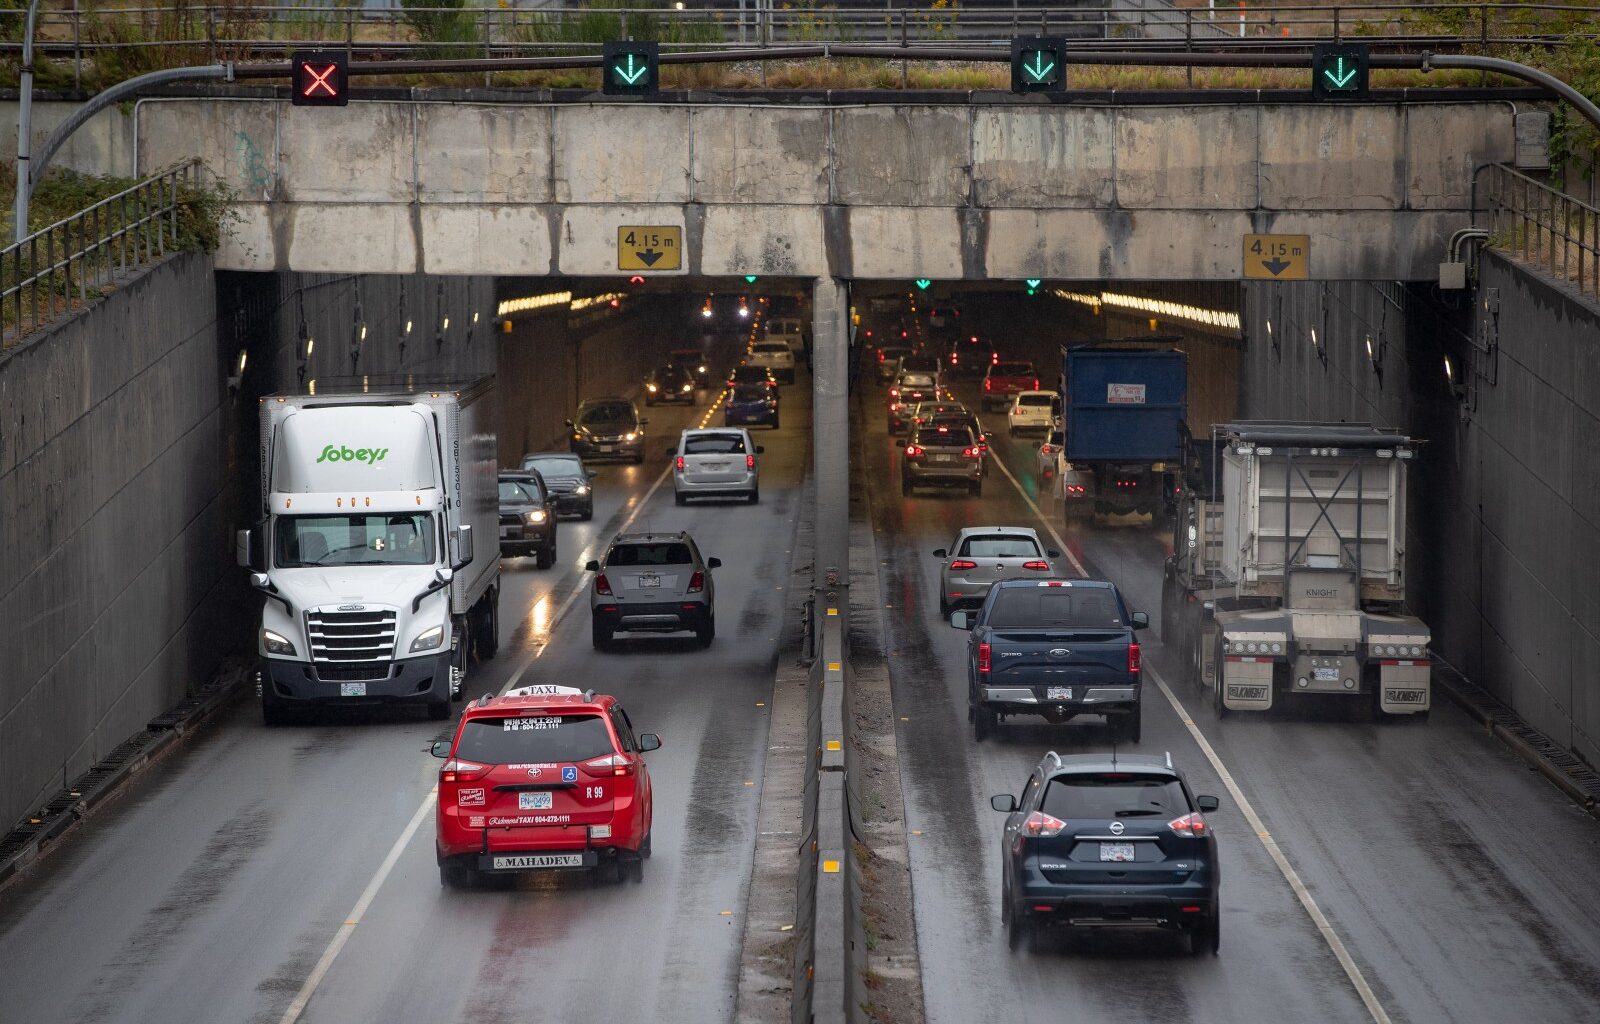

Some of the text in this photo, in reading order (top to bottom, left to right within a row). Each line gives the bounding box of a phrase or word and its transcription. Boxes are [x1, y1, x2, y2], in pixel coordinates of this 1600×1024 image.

[625, 231, 673, 247] 4.15 m
[1251, 240, 1301, 256] 4.15 m
[316, 444, 389, 465] Sobeys
[1305, 588, 1338, 597] KNIGHT
[528, 685, 558, 695] TAXI
[1239, 686, 1267, 698] KNIGHT
[1396, 690, 1425, 702] KNIGHT
[586, 786, 603, 799] R 99
[505, 855, 571, 868] MAHADEV
